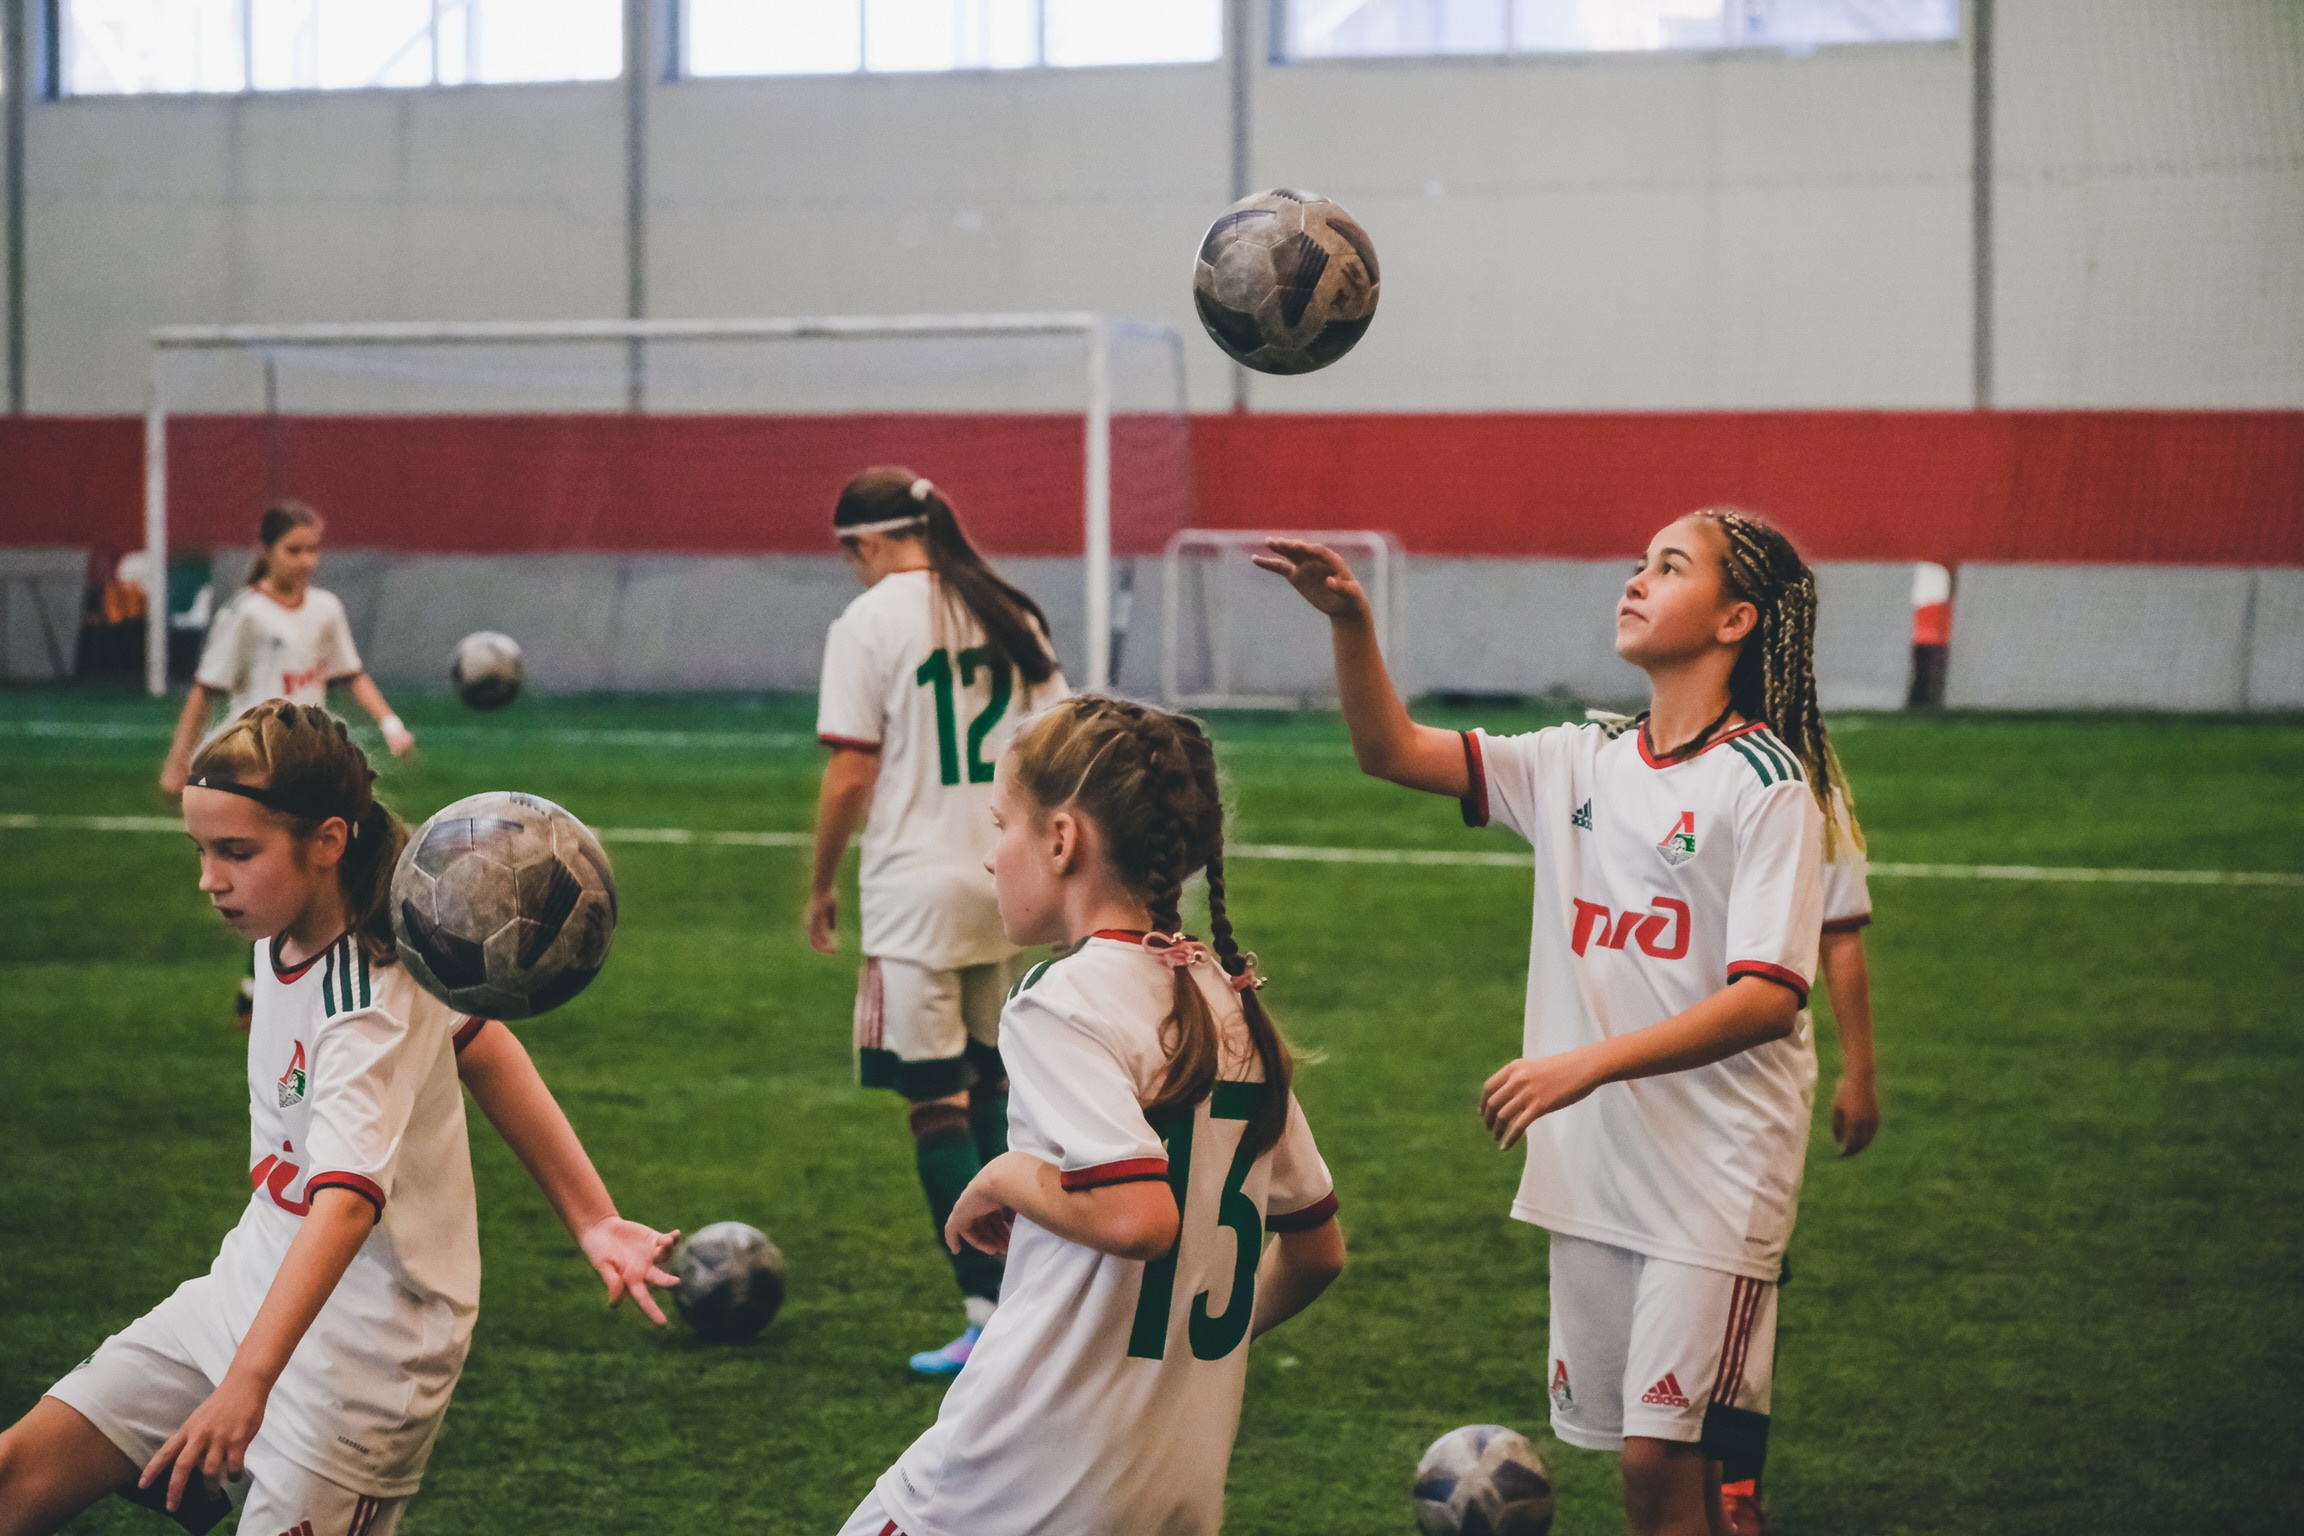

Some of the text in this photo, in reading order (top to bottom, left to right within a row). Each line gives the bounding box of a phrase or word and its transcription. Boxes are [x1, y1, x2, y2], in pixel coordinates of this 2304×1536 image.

[917, 648, 1012, 785] 12
[1127, 1080, 1262, 1361] 13
[1641, 1393, 1690, 1408] adidas
